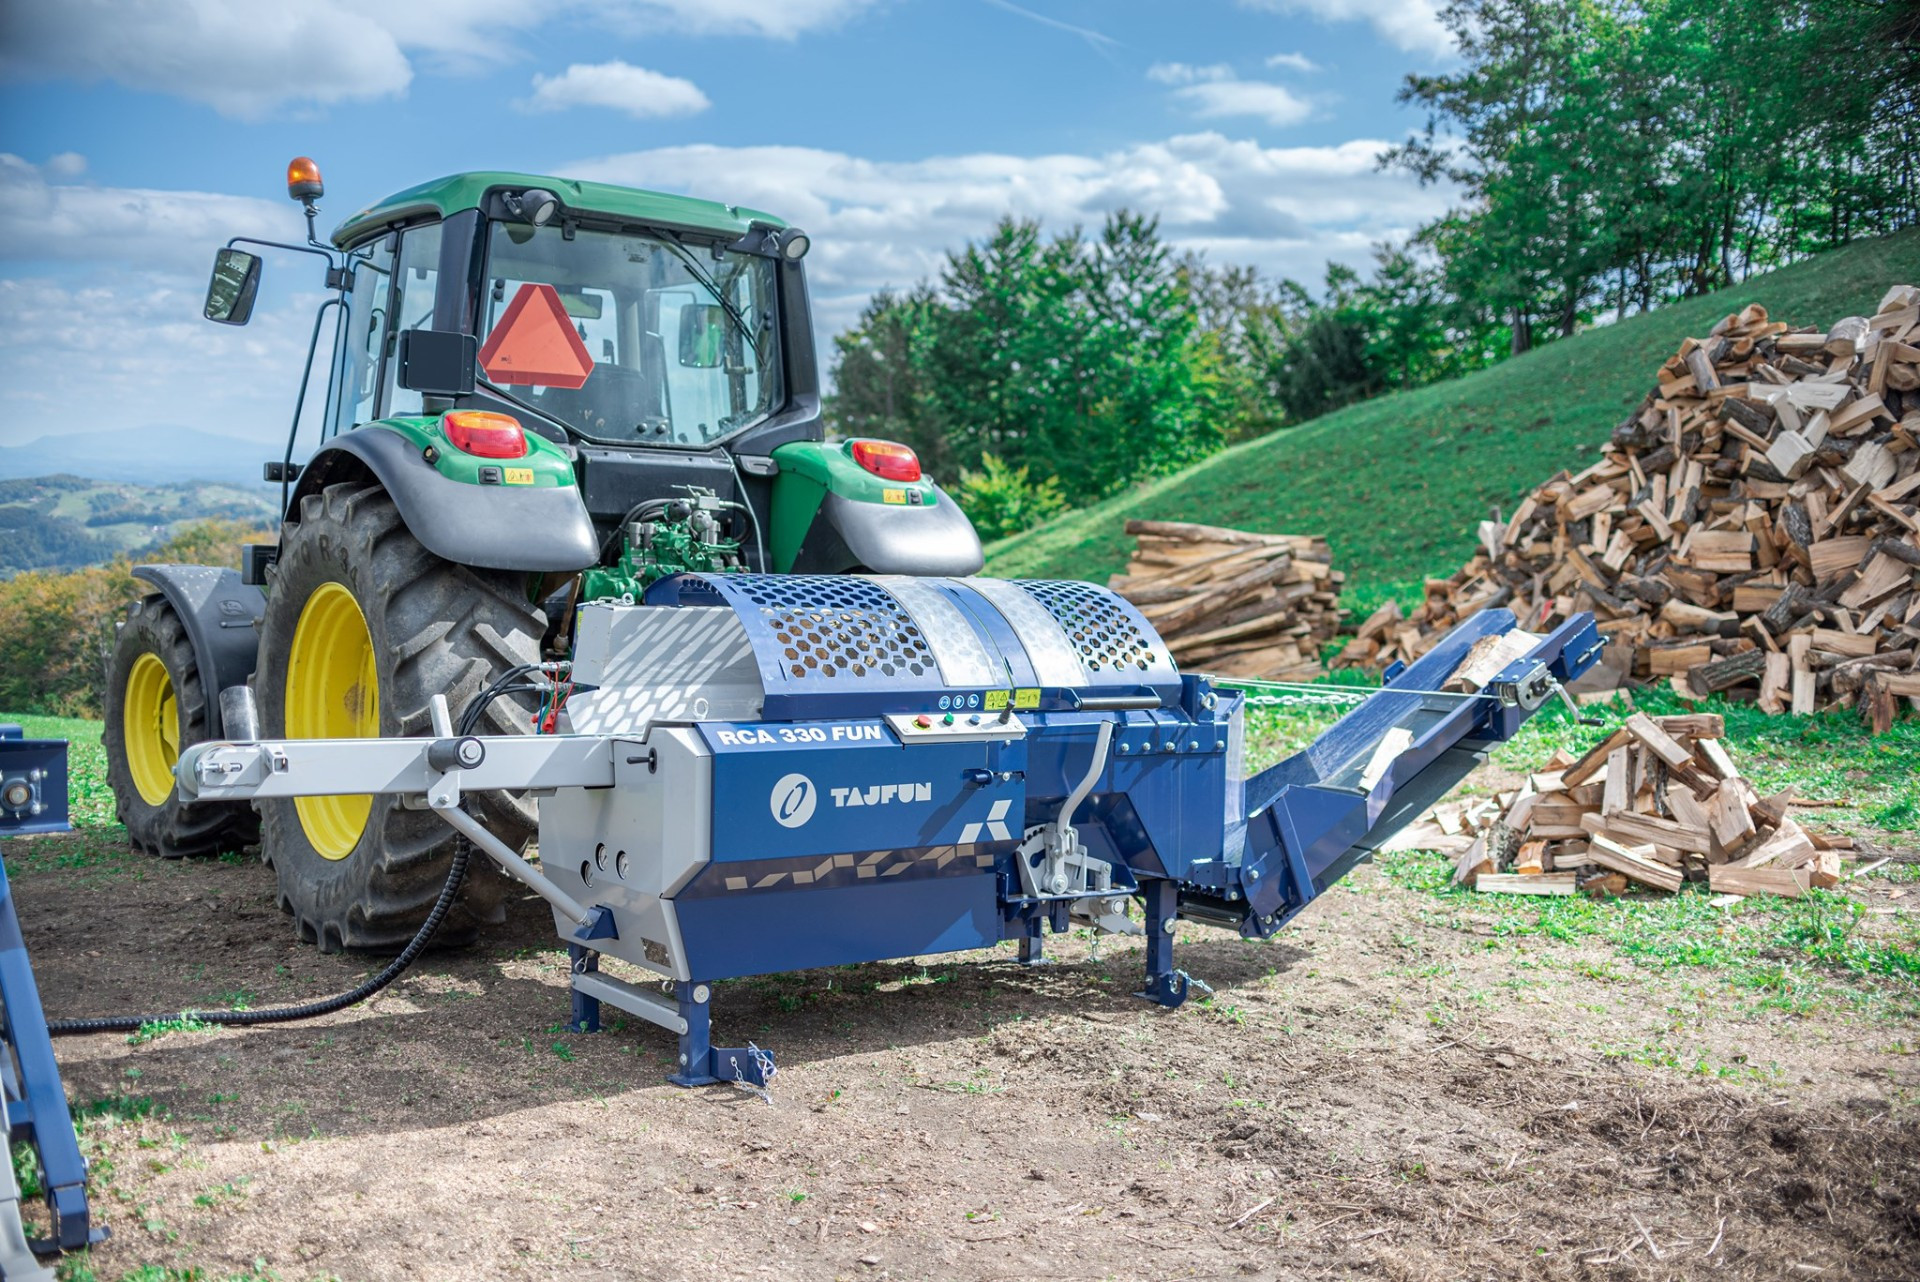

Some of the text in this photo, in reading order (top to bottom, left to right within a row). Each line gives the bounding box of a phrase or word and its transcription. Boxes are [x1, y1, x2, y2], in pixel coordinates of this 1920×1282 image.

[716, 725, 882, 746] RCA 330 FUN
[830, 782, 932, 807] TAJFUN
